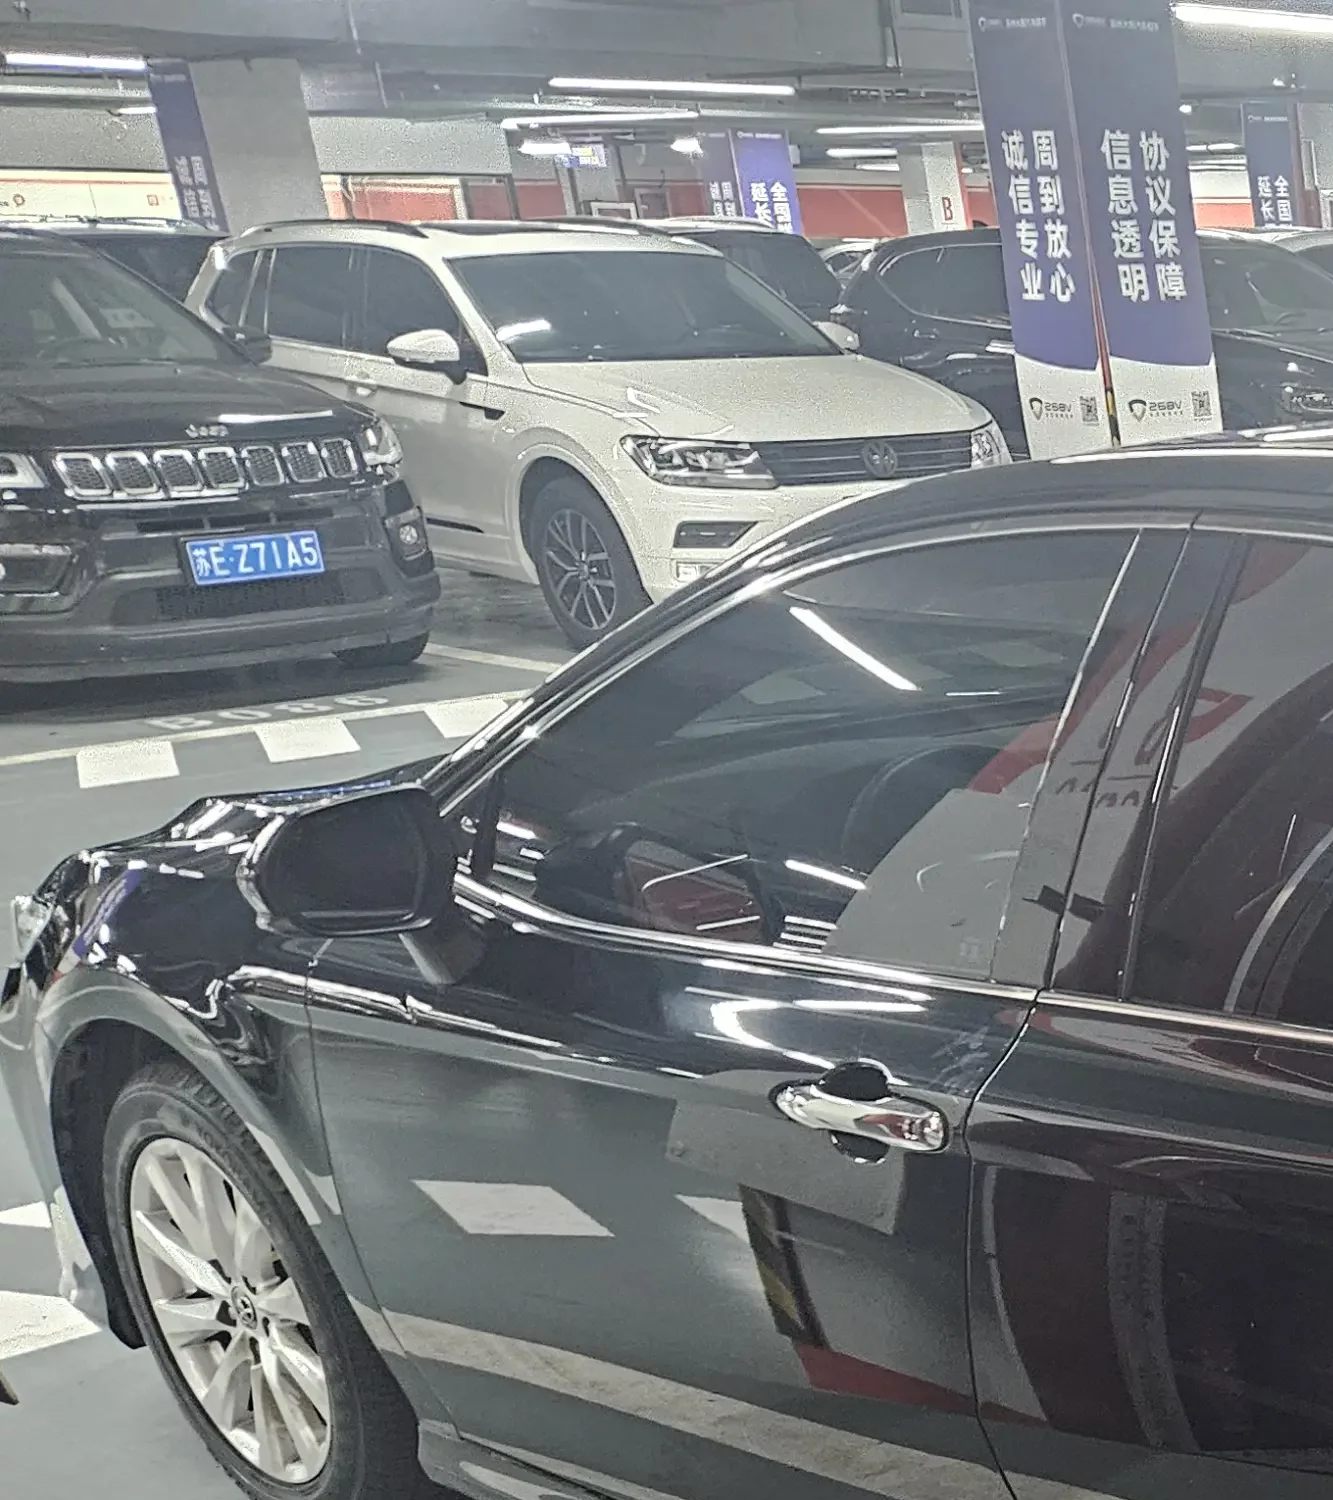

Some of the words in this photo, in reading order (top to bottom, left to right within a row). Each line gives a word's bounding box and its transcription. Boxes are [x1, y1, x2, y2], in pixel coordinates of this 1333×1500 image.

[942, 197, 954, 221] B
[1001, 129, 1046, 301] 诚信专业
[1032, 130, 1076, 302] 周到放心
[1101, 129, 1150, 302] 信息透明
[1139, 130, 1188, 301] 协议保障
[1257, 175, 1277, 228] 延长
[1273, 175, 1293, 228] 全国
